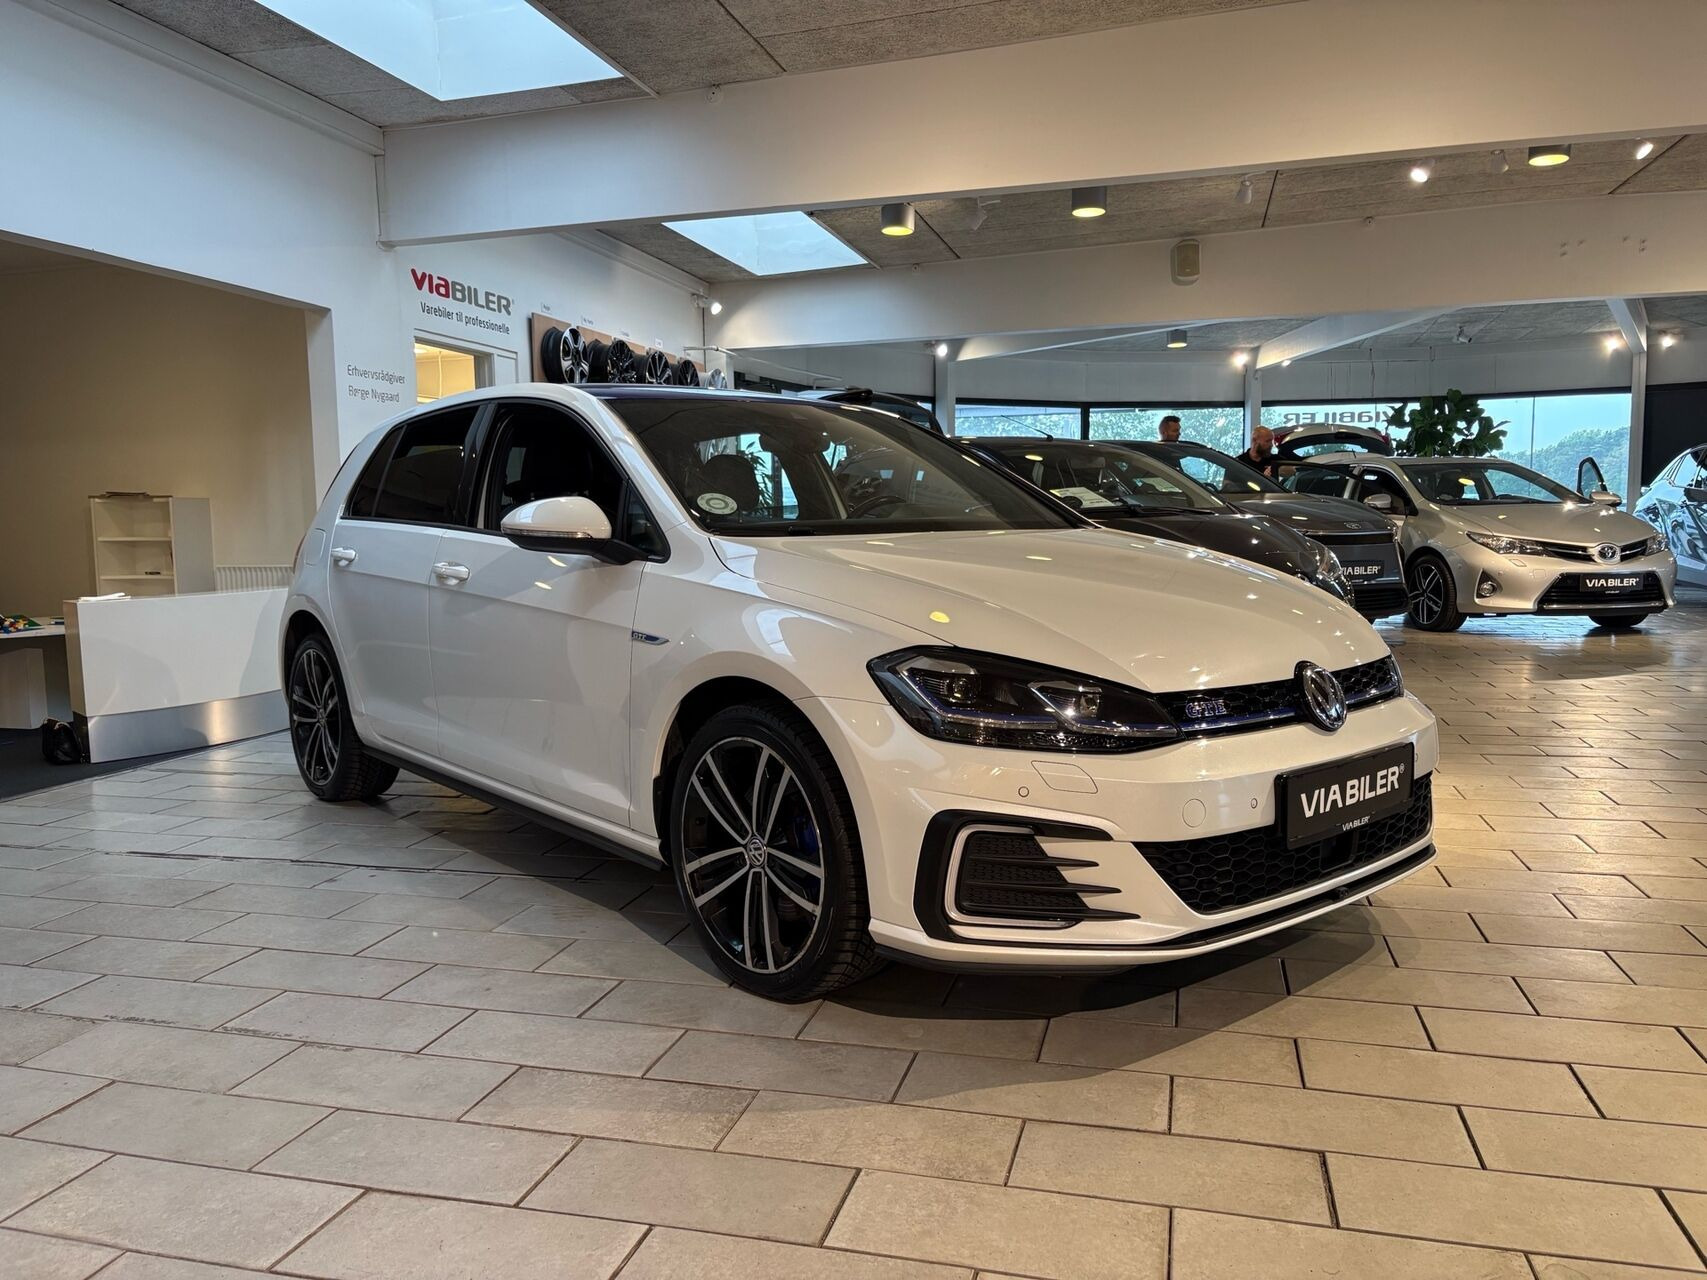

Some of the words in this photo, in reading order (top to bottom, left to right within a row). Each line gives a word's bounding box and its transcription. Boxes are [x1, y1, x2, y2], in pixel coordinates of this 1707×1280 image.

[420, 301, 454, 320] Varebiler
[455, 311, 463, 323] til
[464, 315, 510, 335] professionelle
[347, 364, 406, 385] Erhvervsrådgiver
[1185, 700, 1227, 718] GTE
